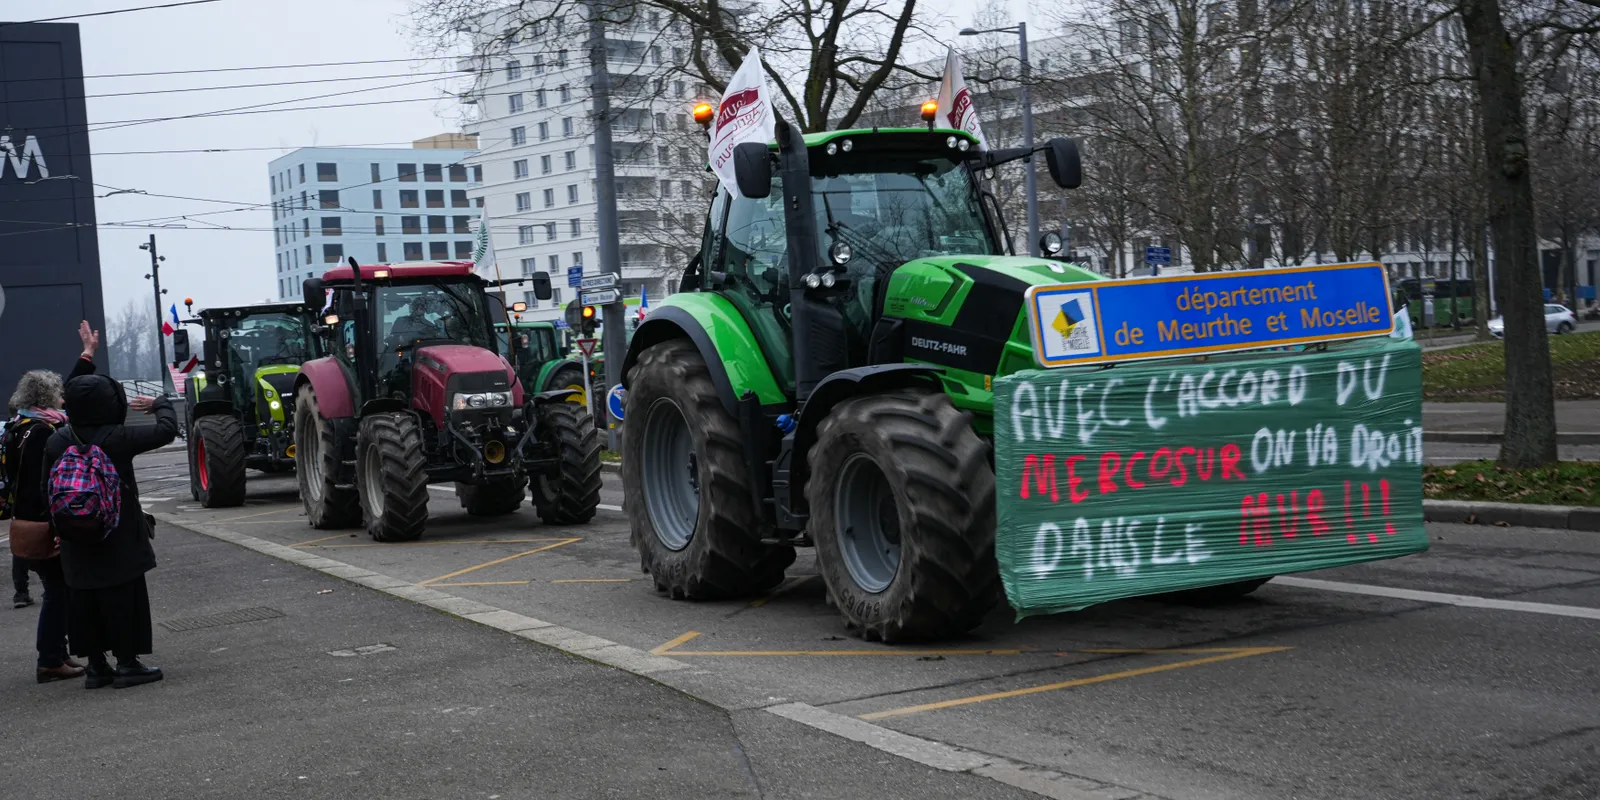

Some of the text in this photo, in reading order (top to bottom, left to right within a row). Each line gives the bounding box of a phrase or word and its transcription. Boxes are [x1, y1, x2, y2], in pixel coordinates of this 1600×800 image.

[1114, 301, 1381, 346] de Meurthe et Moselle
[1176, 281, 1318, 315] département
[911, 336, 967, 356] DEUTZ-FAHR
[1011, 353, 1391, 444] AVEC L'ACCORD DU
[1020, 444, 1246, 503] MERCOSUR
[1250, 426, 1297, 474] ON
[1304, 422, 1338, 467] VA
[1239, 488, 1331, 546] MUR
[1030, 515, 1215, 581] DANS LE
